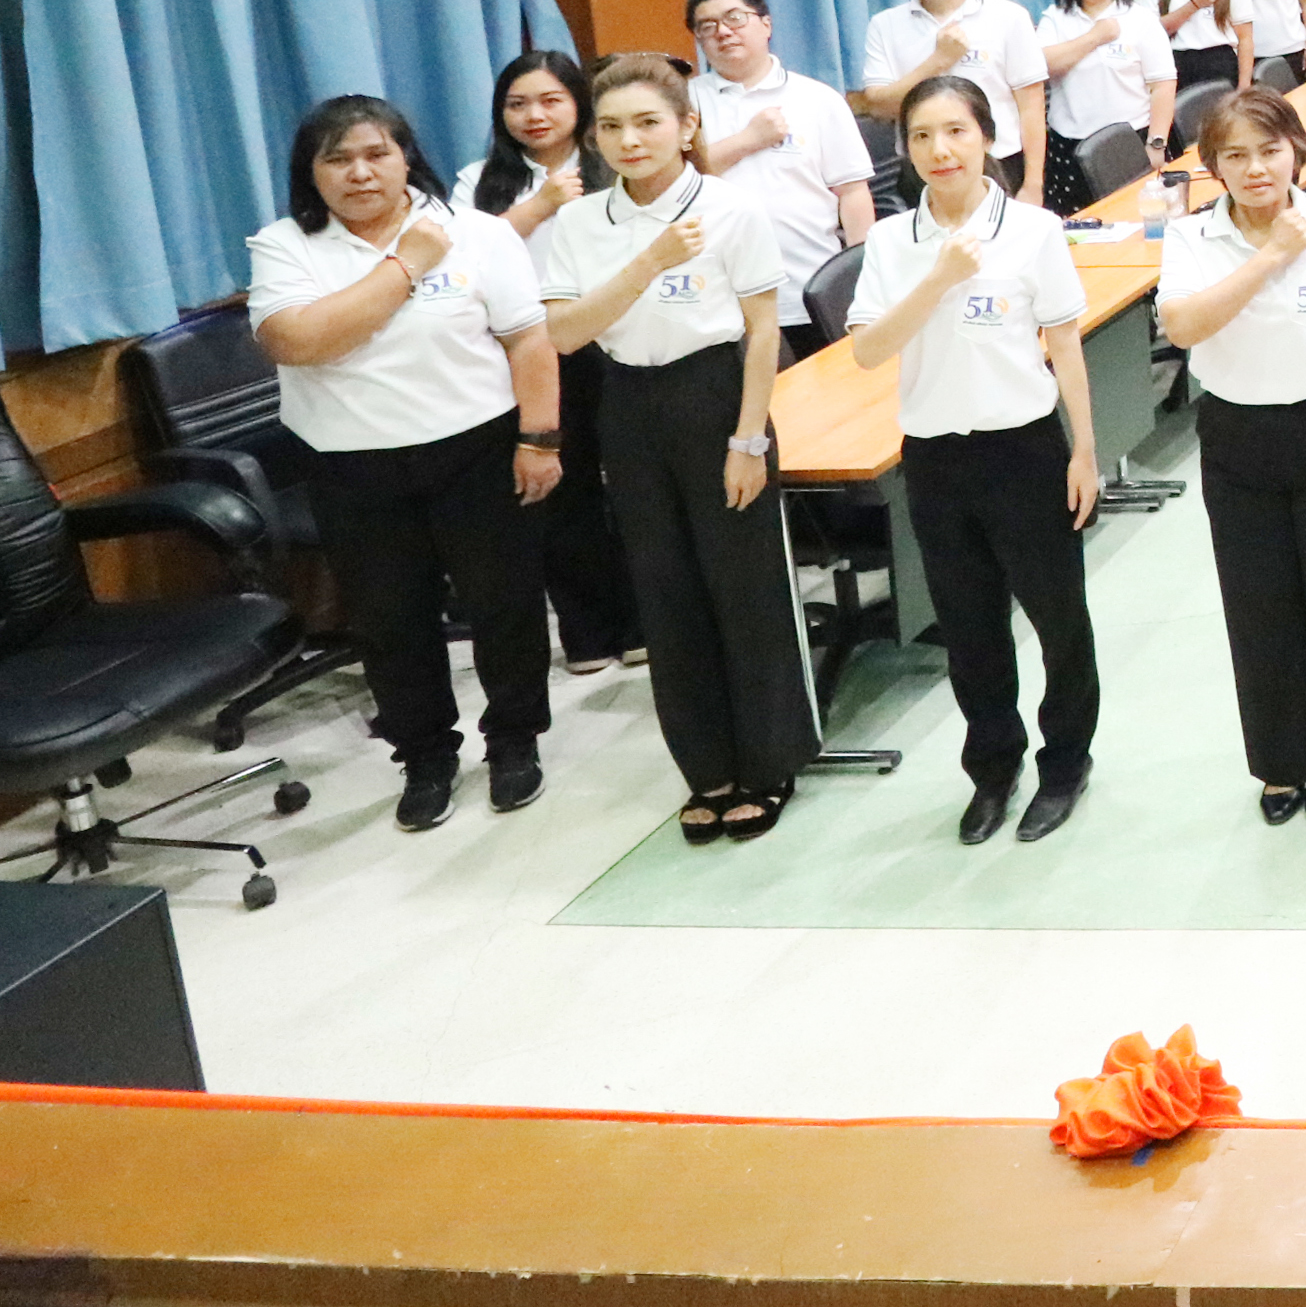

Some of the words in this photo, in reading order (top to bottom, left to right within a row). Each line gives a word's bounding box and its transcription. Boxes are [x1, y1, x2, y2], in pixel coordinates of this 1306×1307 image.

[422, 272, 450, 296] 51
[659, 275, 690, 298] 51
[964, 296, 993, 319] 51
